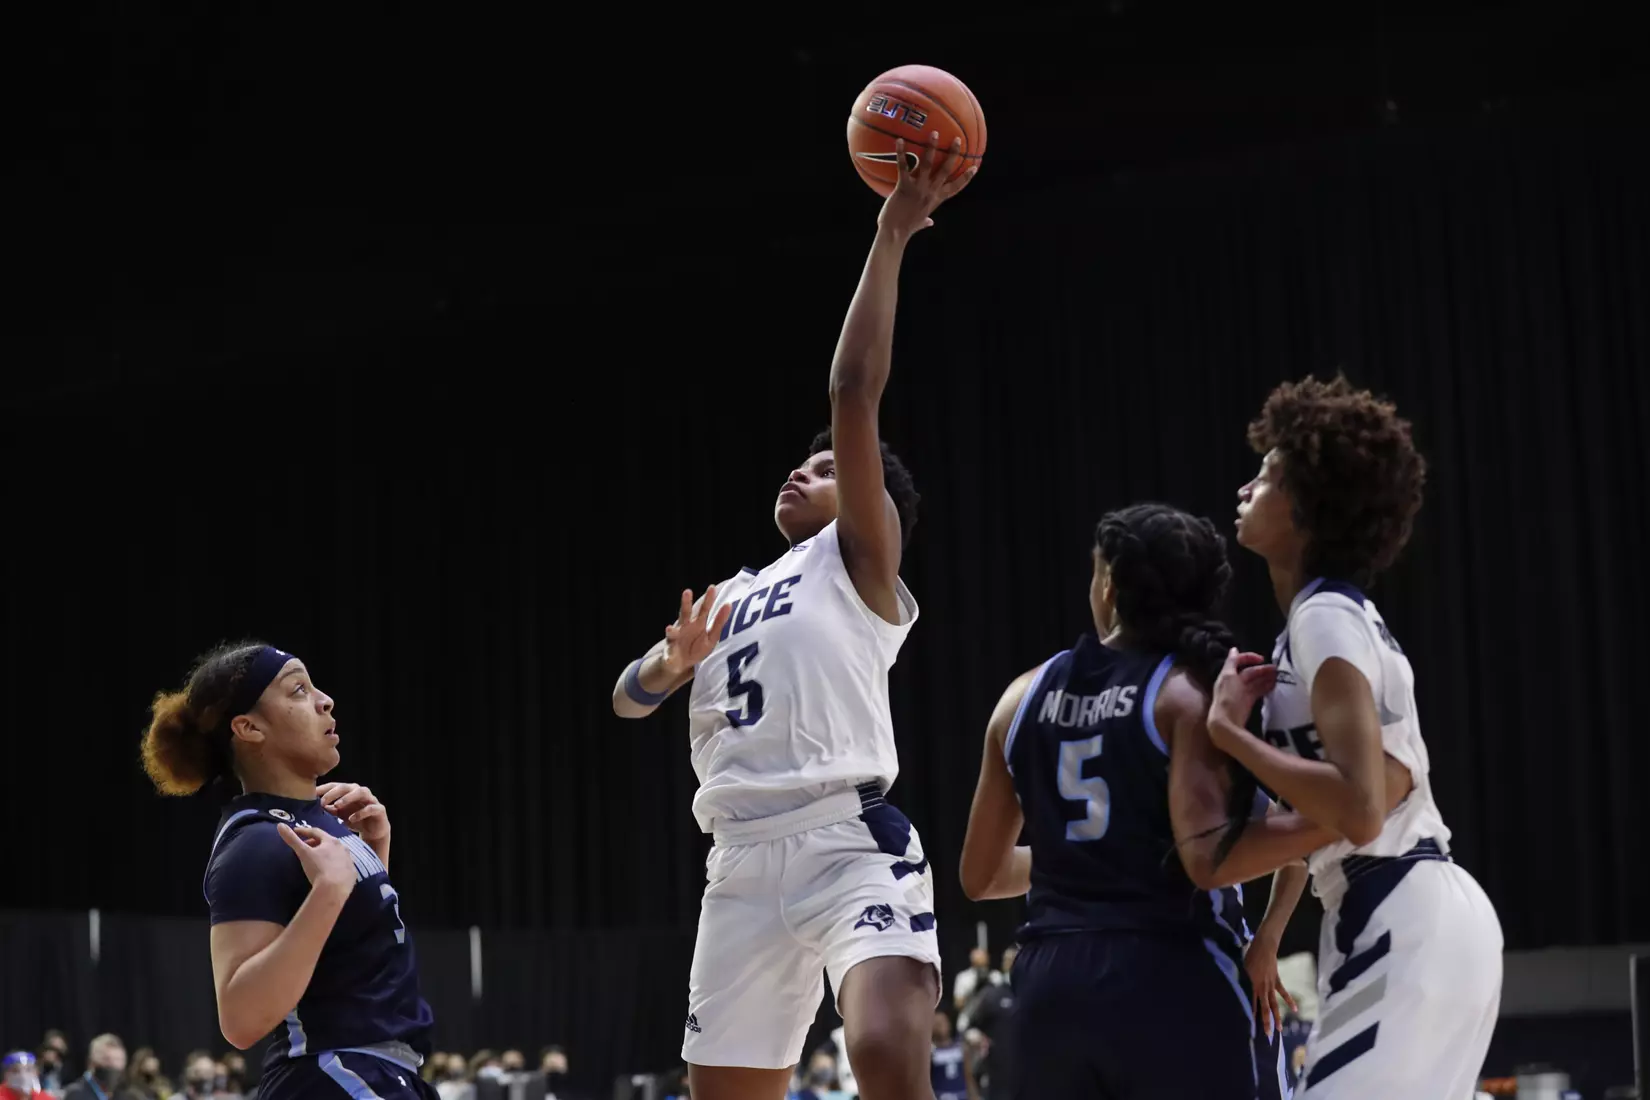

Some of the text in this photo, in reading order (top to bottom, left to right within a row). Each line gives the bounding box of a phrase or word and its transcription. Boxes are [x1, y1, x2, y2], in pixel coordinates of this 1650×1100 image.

[866, 95, 927, 130] ELITE
[718, 574, 802, 642] ICE
[726, 642, 763, 728] 5
[1038, 685, 1138, 728] MORRIS
[1057, 735, 1110, 841] 5
